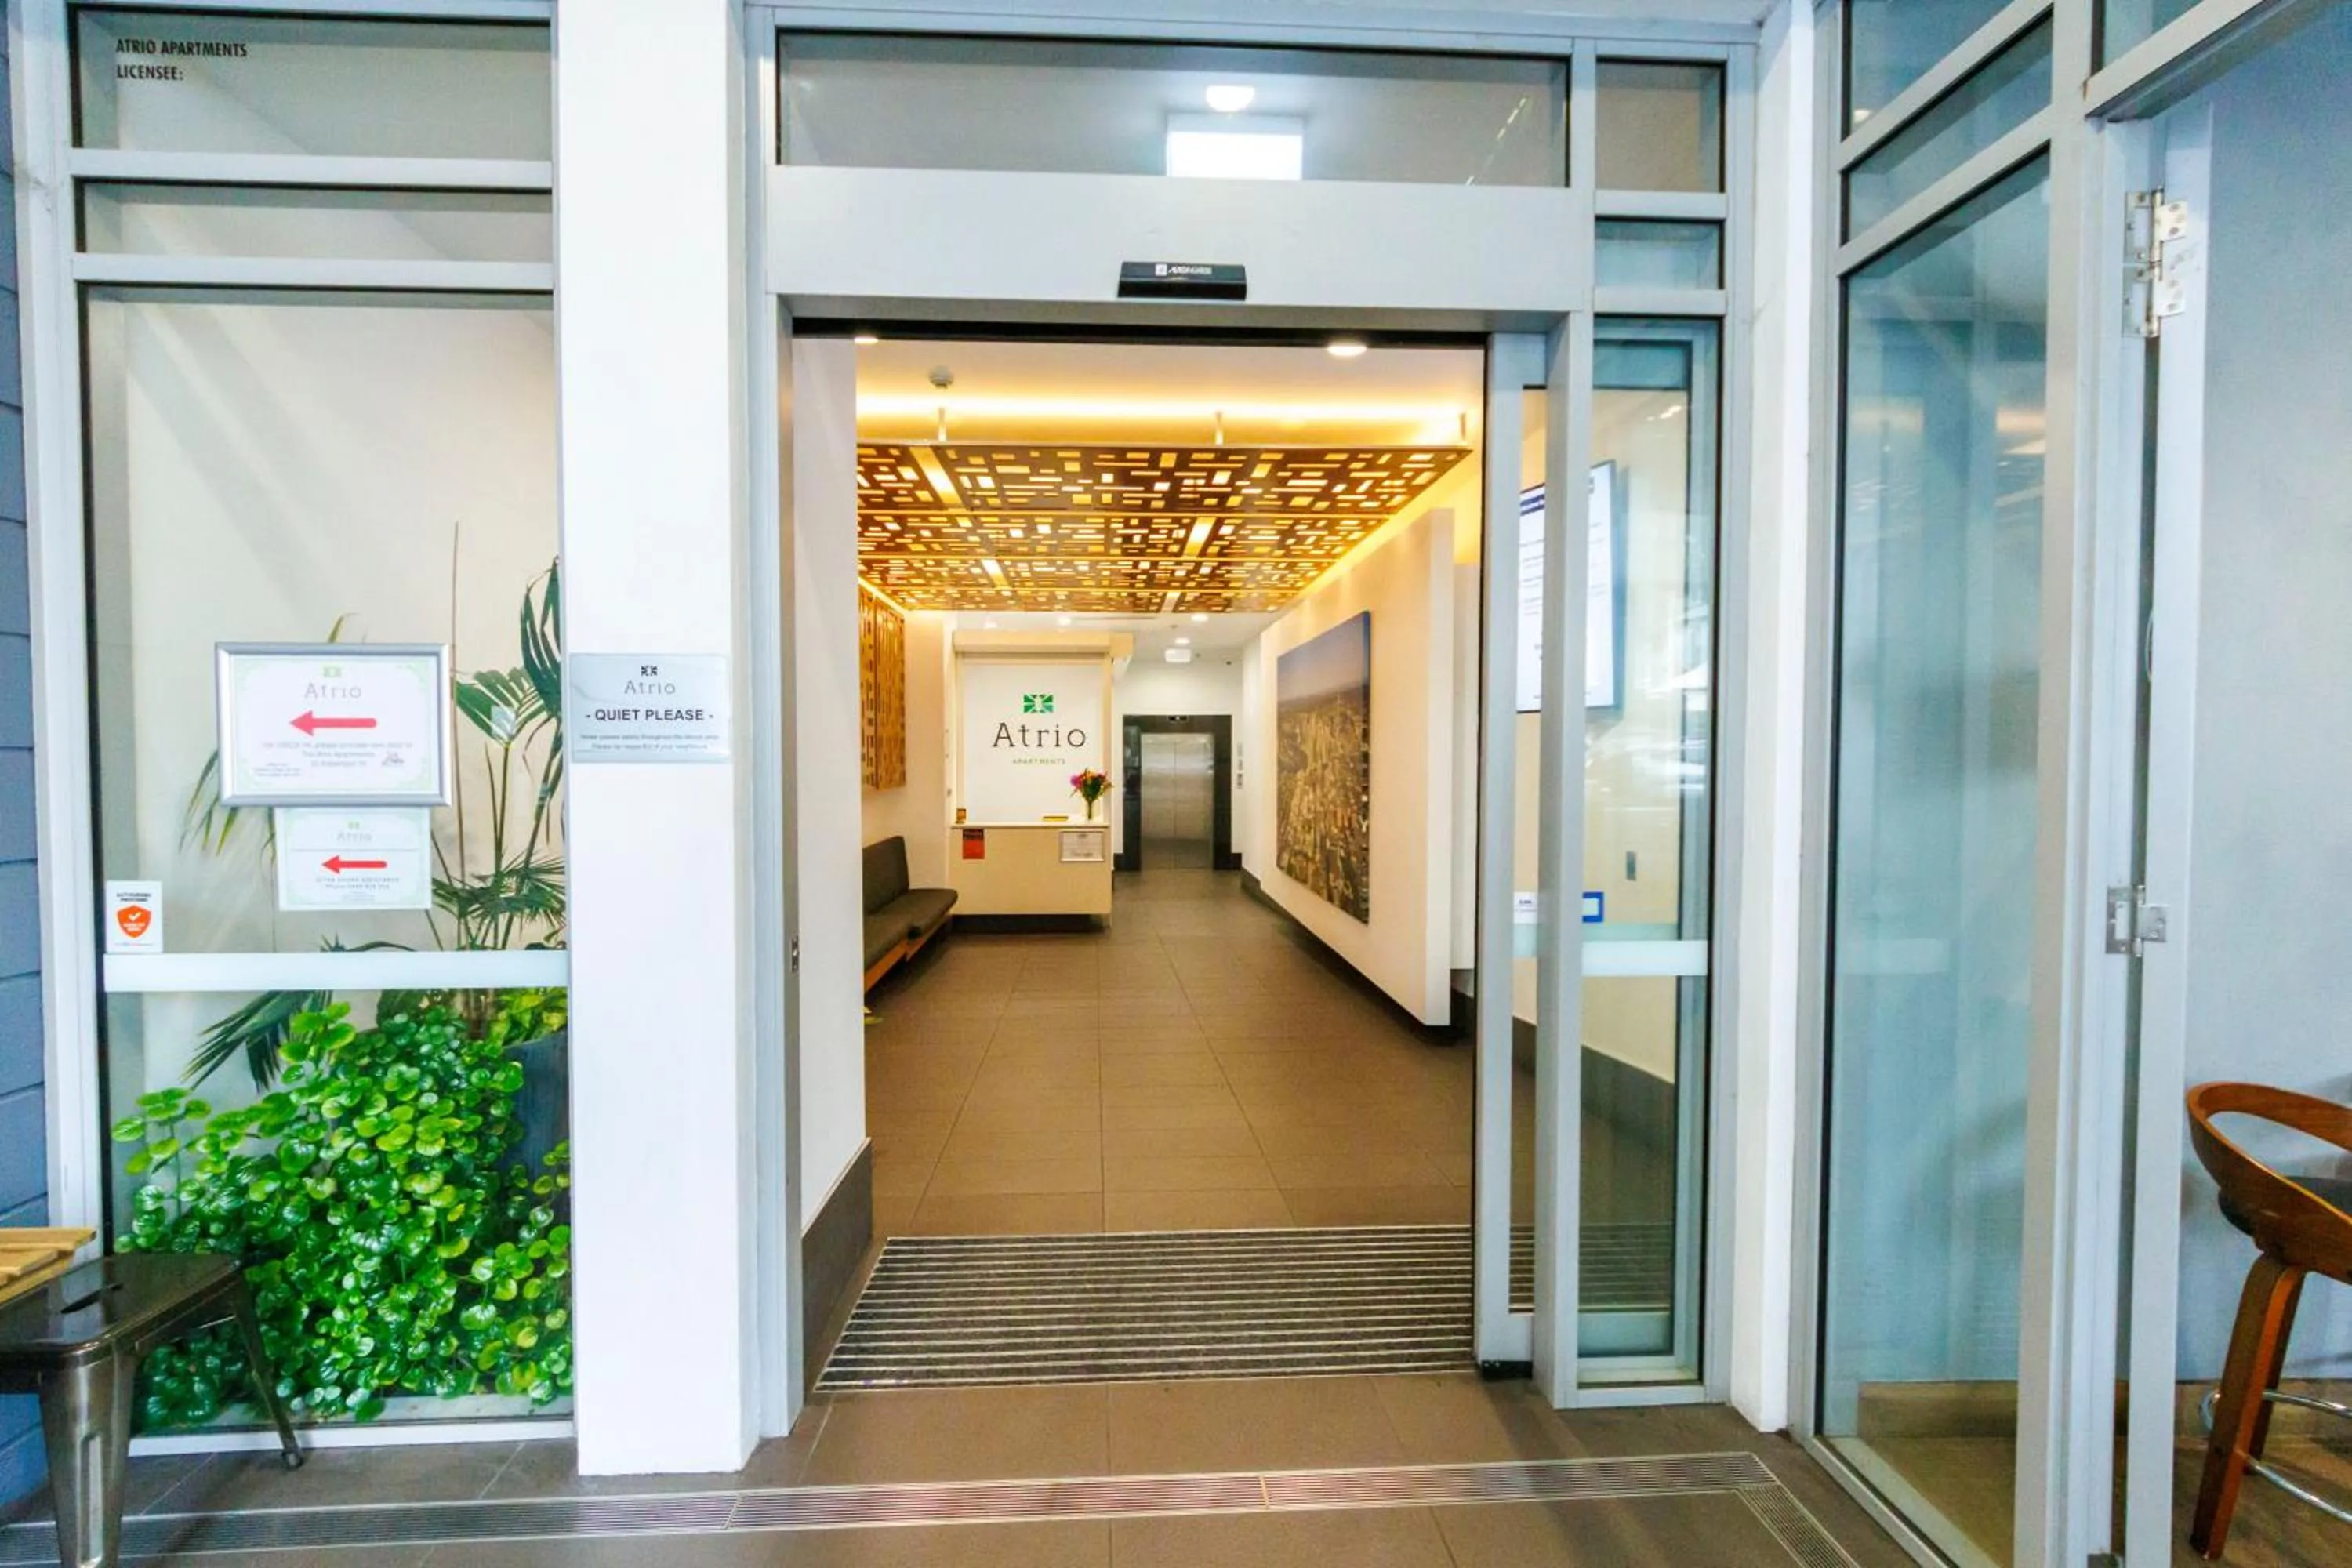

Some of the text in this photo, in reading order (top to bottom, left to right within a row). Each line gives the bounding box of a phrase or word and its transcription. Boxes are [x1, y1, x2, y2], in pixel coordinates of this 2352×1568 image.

[116, 38, 247, 57] ATRIO APARTMENTS
[117, 64, 184, 81] LICENSEE:
[303, 682, 362, 699] Atrio
[624, 680, 676, 695] Atrio
[594, 709, 705, 720] QUIET PLEASE
[992, 722, 1087, 748] Atrio
